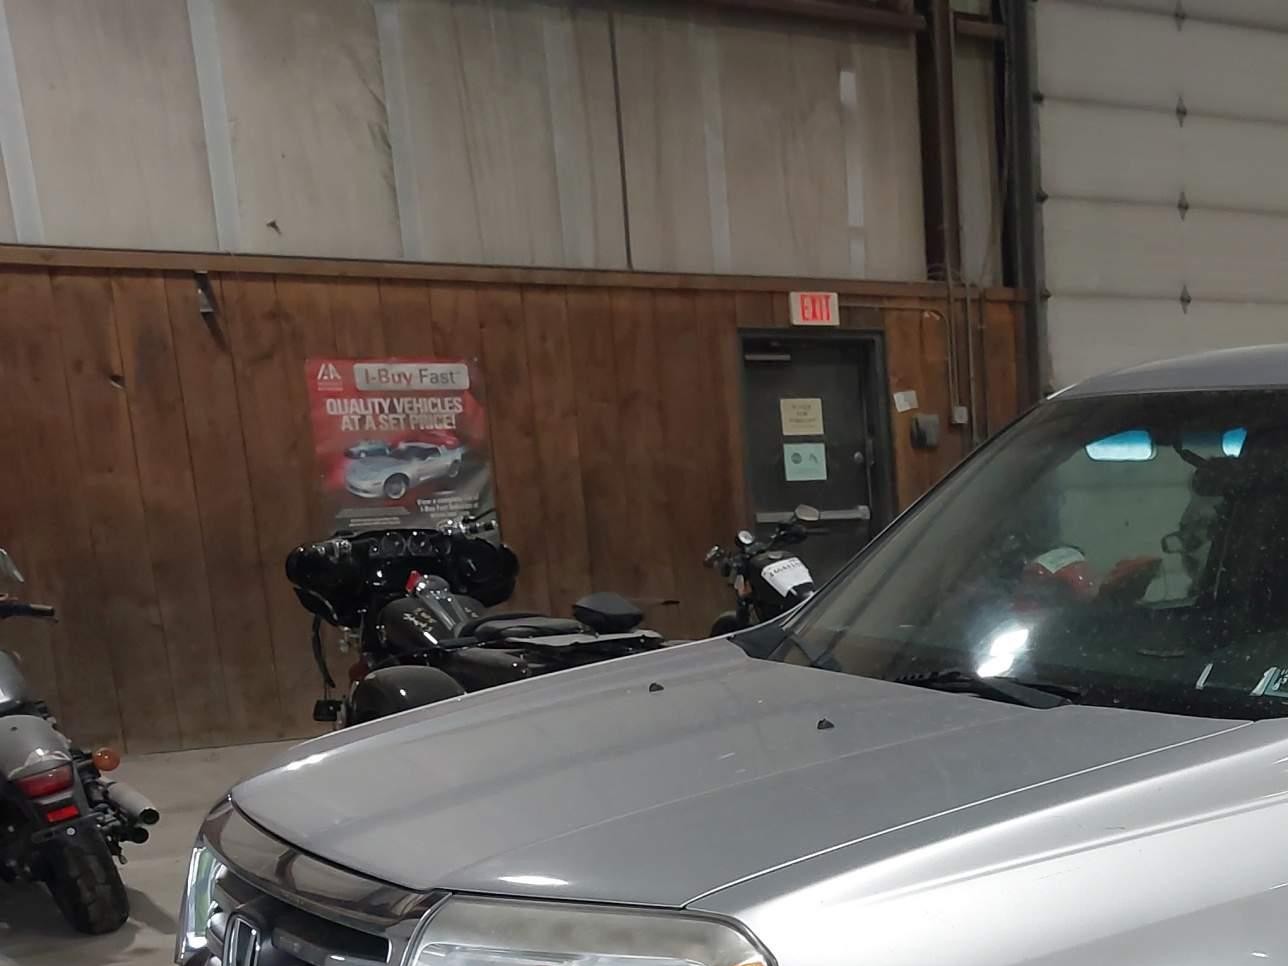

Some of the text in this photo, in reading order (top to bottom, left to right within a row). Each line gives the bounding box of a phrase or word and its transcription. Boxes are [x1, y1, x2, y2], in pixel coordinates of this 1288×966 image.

[800, 294, 831, 321] EXIT
[364, 368, 413, 386] I-Buy
[326, 397, 464, 416] QUALITY VEHICLES
[341, 413, 457, 431] AT A SET PRICE!
